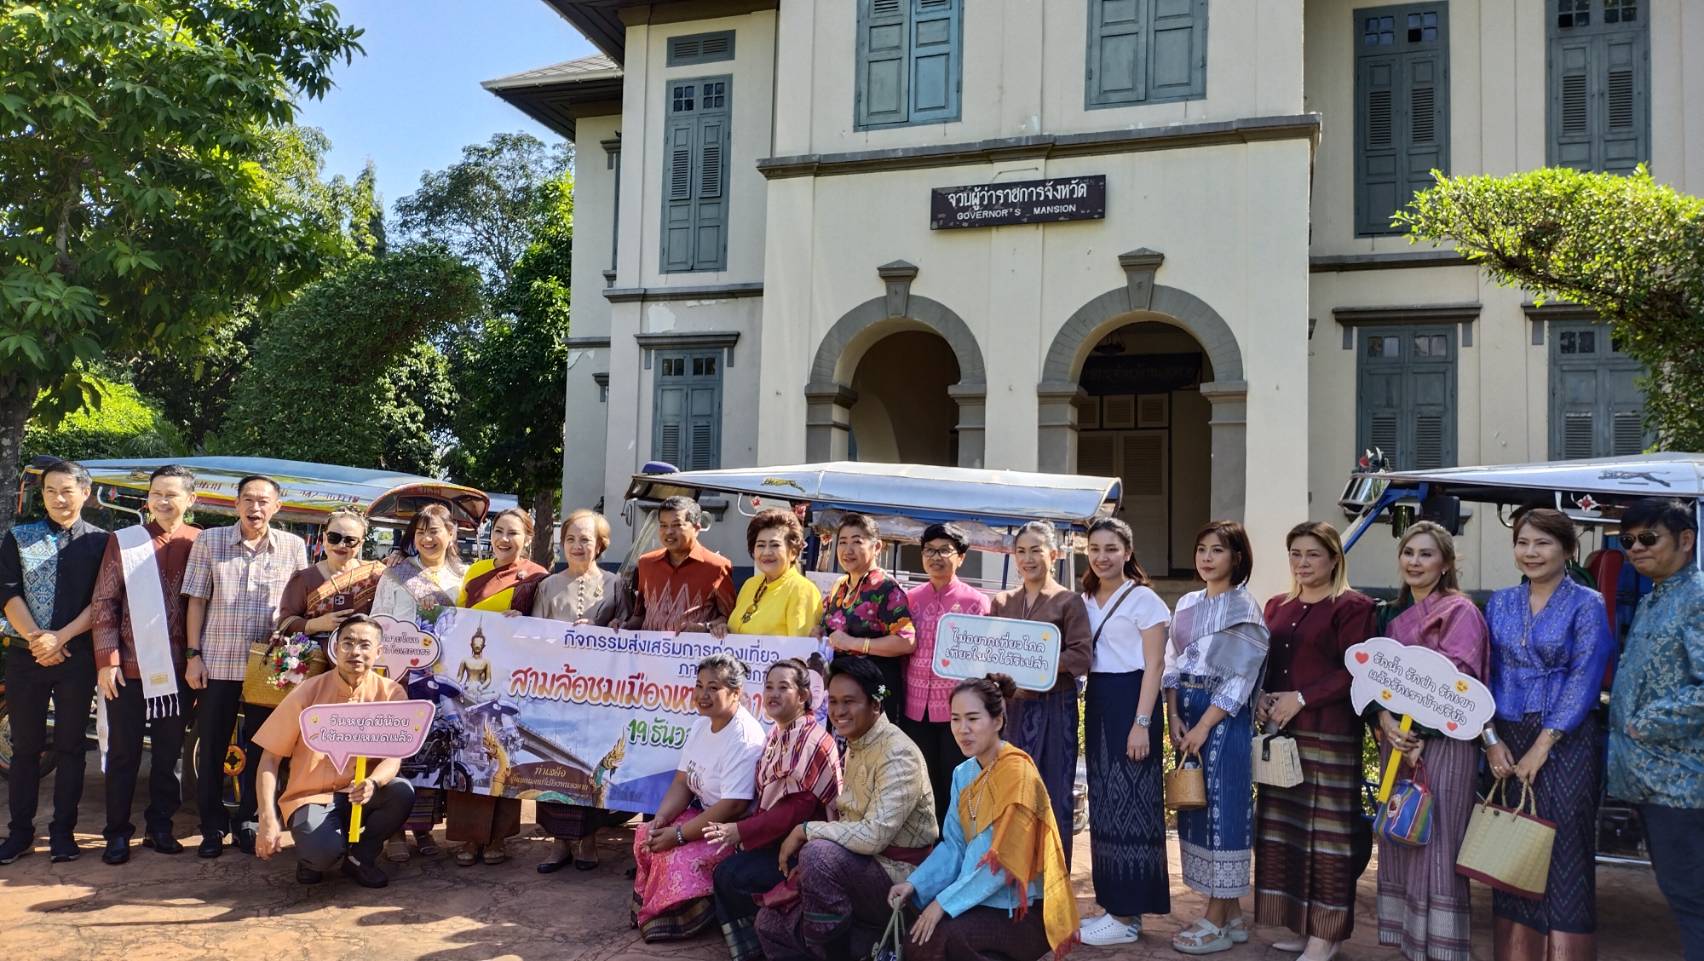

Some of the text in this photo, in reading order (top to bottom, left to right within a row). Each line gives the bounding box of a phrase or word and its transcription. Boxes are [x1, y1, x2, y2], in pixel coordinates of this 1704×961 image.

[948, 180, 1086, 210] จวนผู้ว่าราชการจังหวัด
[1033, 204, 1076, 215] MANSION
